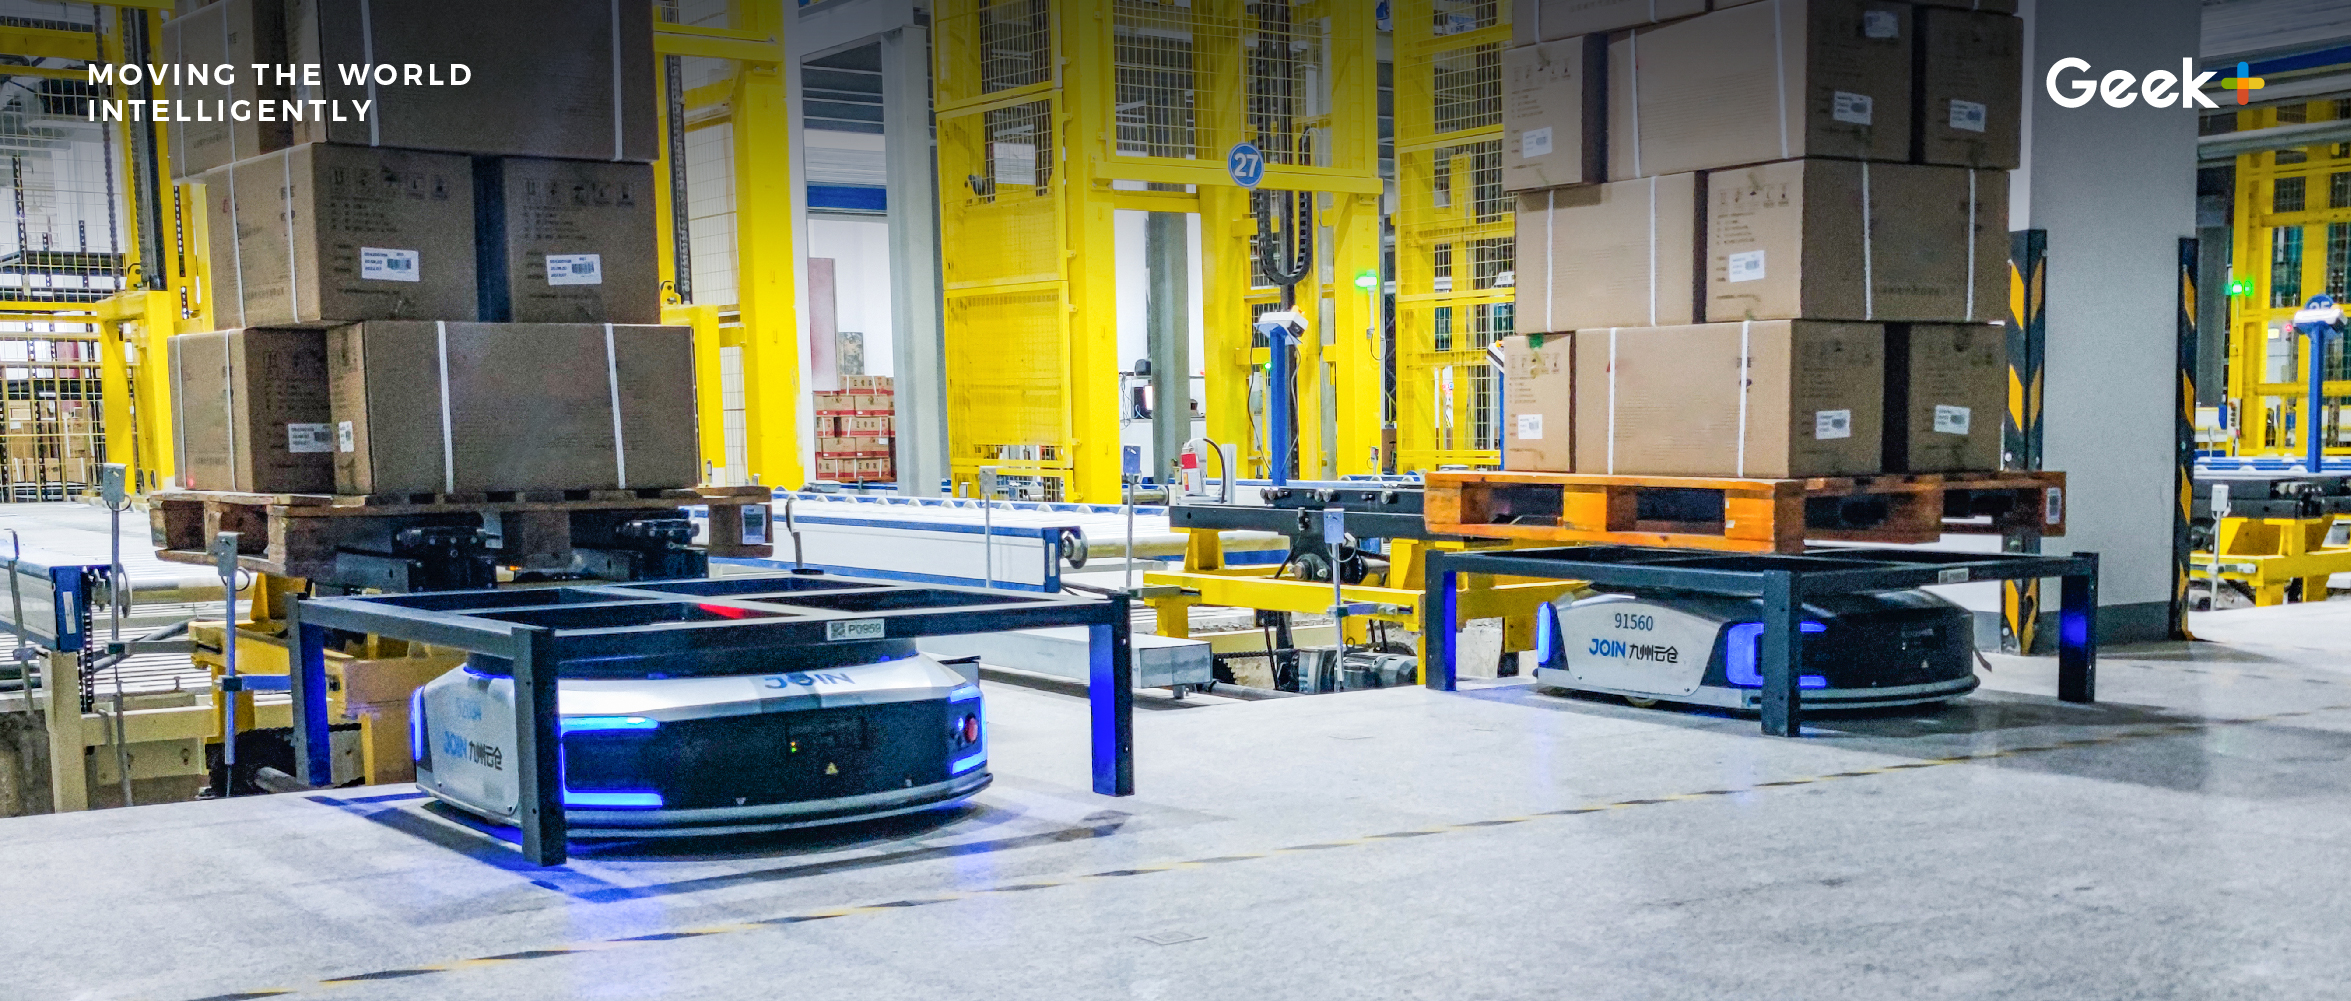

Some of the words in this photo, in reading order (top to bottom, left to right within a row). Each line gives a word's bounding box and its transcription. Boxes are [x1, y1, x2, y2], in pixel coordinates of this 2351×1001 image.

[1234, 152, 1259, 178] 27
[1614, 612, 1654, 631] 91560
[1589, 638, 1627, 659] JOIN
[1629, 643, 1679, 664] 九州云仓
[764, 672, 856, 689] JOIN
